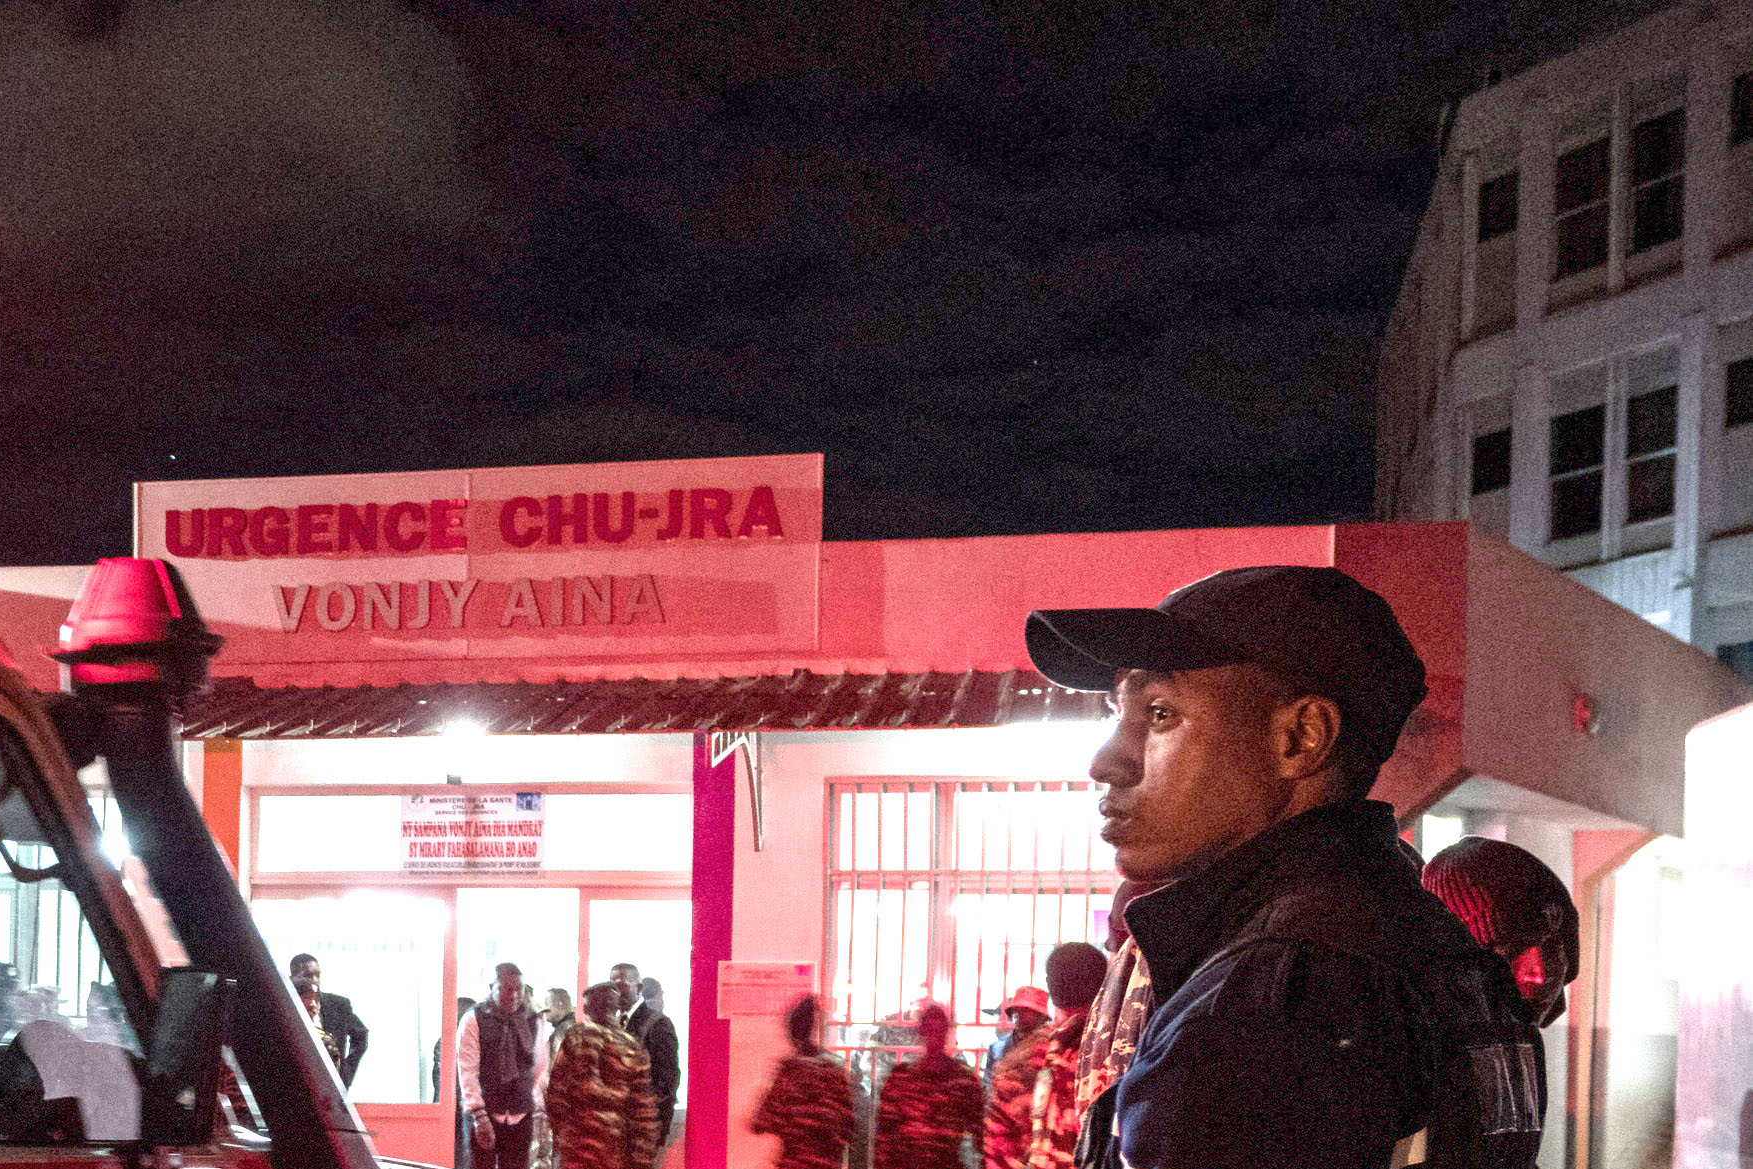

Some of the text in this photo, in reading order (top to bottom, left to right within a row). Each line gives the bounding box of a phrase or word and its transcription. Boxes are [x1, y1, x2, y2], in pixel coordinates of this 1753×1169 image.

[164, 485, 784, 557] URGENCE CHU-JRA
[272, 573, 666, 632] VONJY AINA
